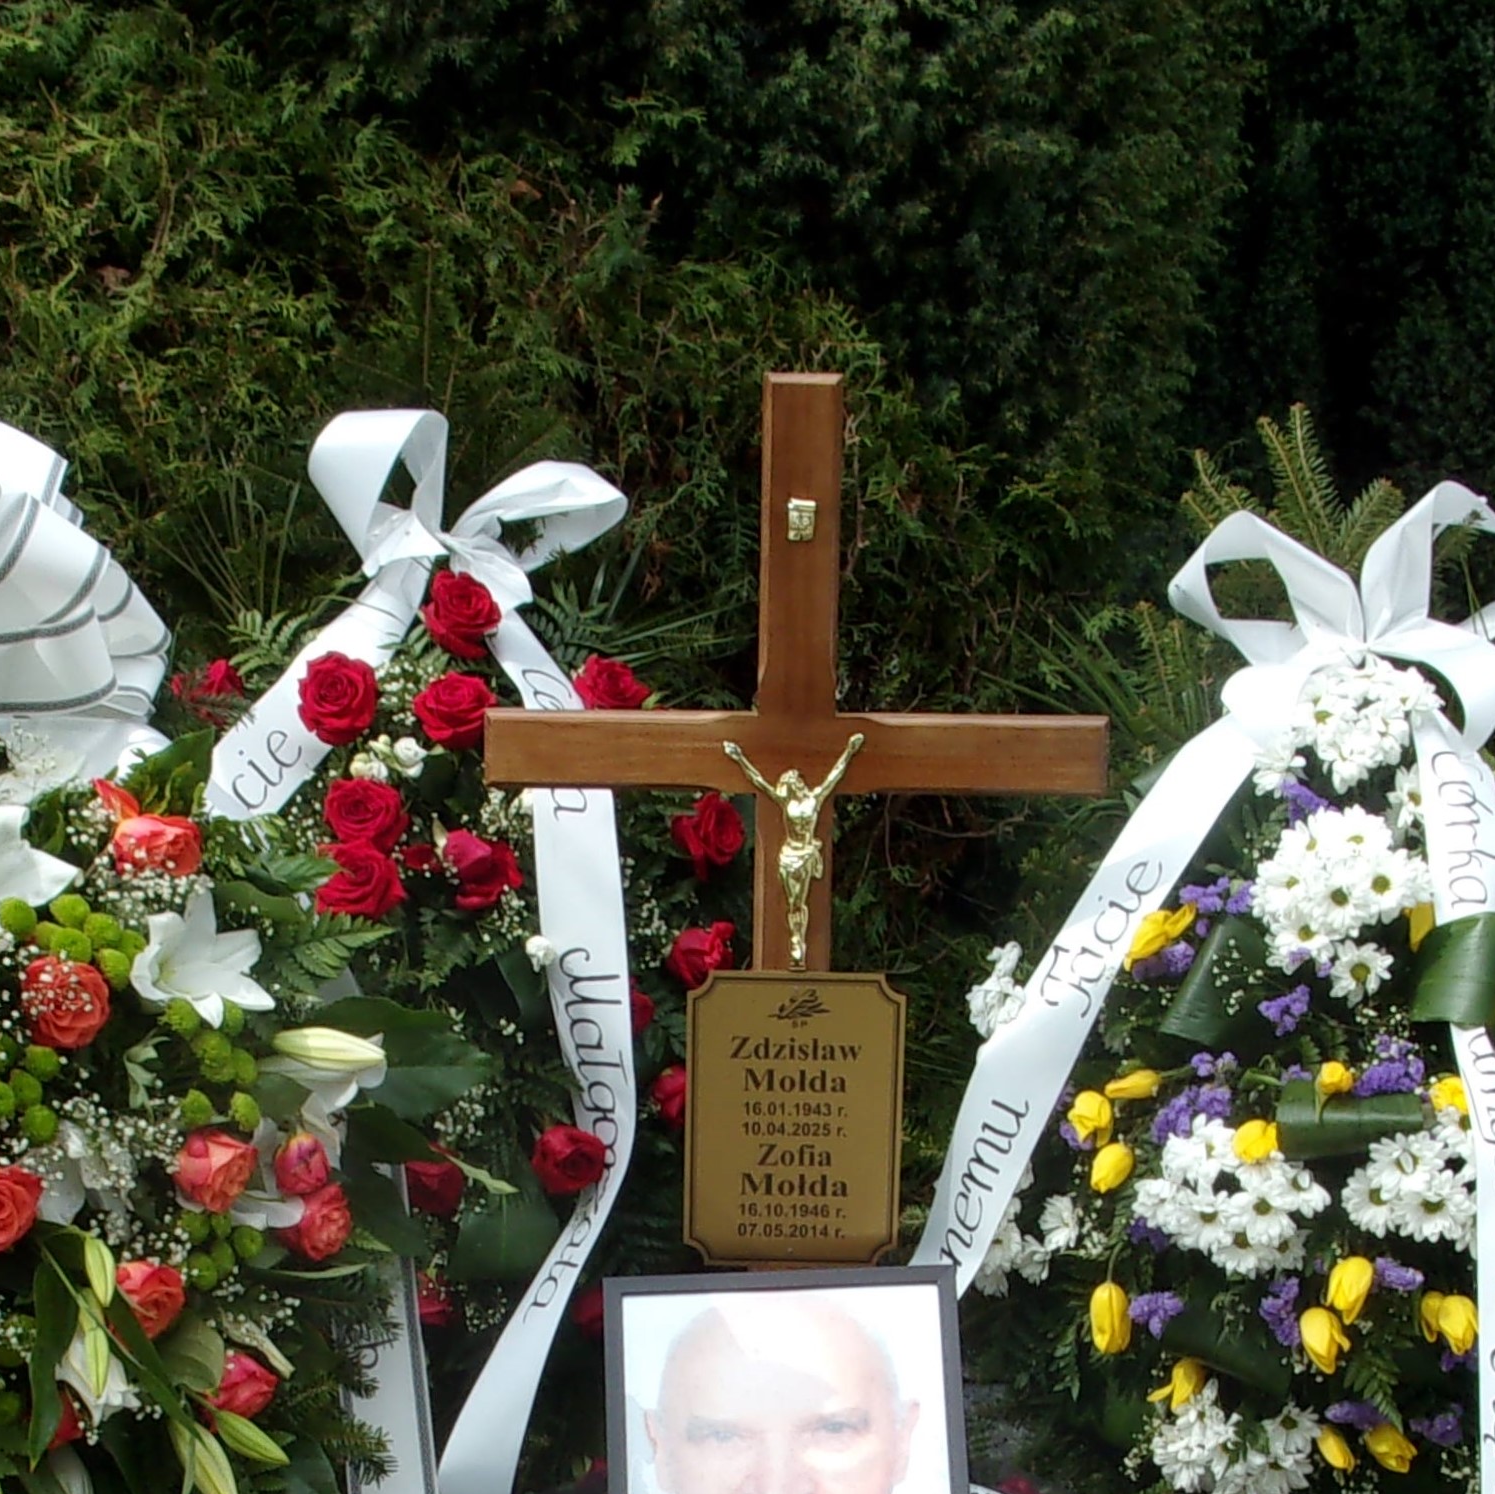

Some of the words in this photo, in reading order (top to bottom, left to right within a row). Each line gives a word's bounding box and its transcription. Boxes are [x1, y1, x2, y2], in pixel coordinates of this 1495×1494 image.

[743, 1102, 832, 1117] 16.01.1943
[742, 1121, 831, 1137] 10.04.2025
[757, 1143, 832, 1168] Zofia
[739, 1203, 830, 1219] 16.10.1946
[737, 1223, 829, 1238] 07.05.2014
